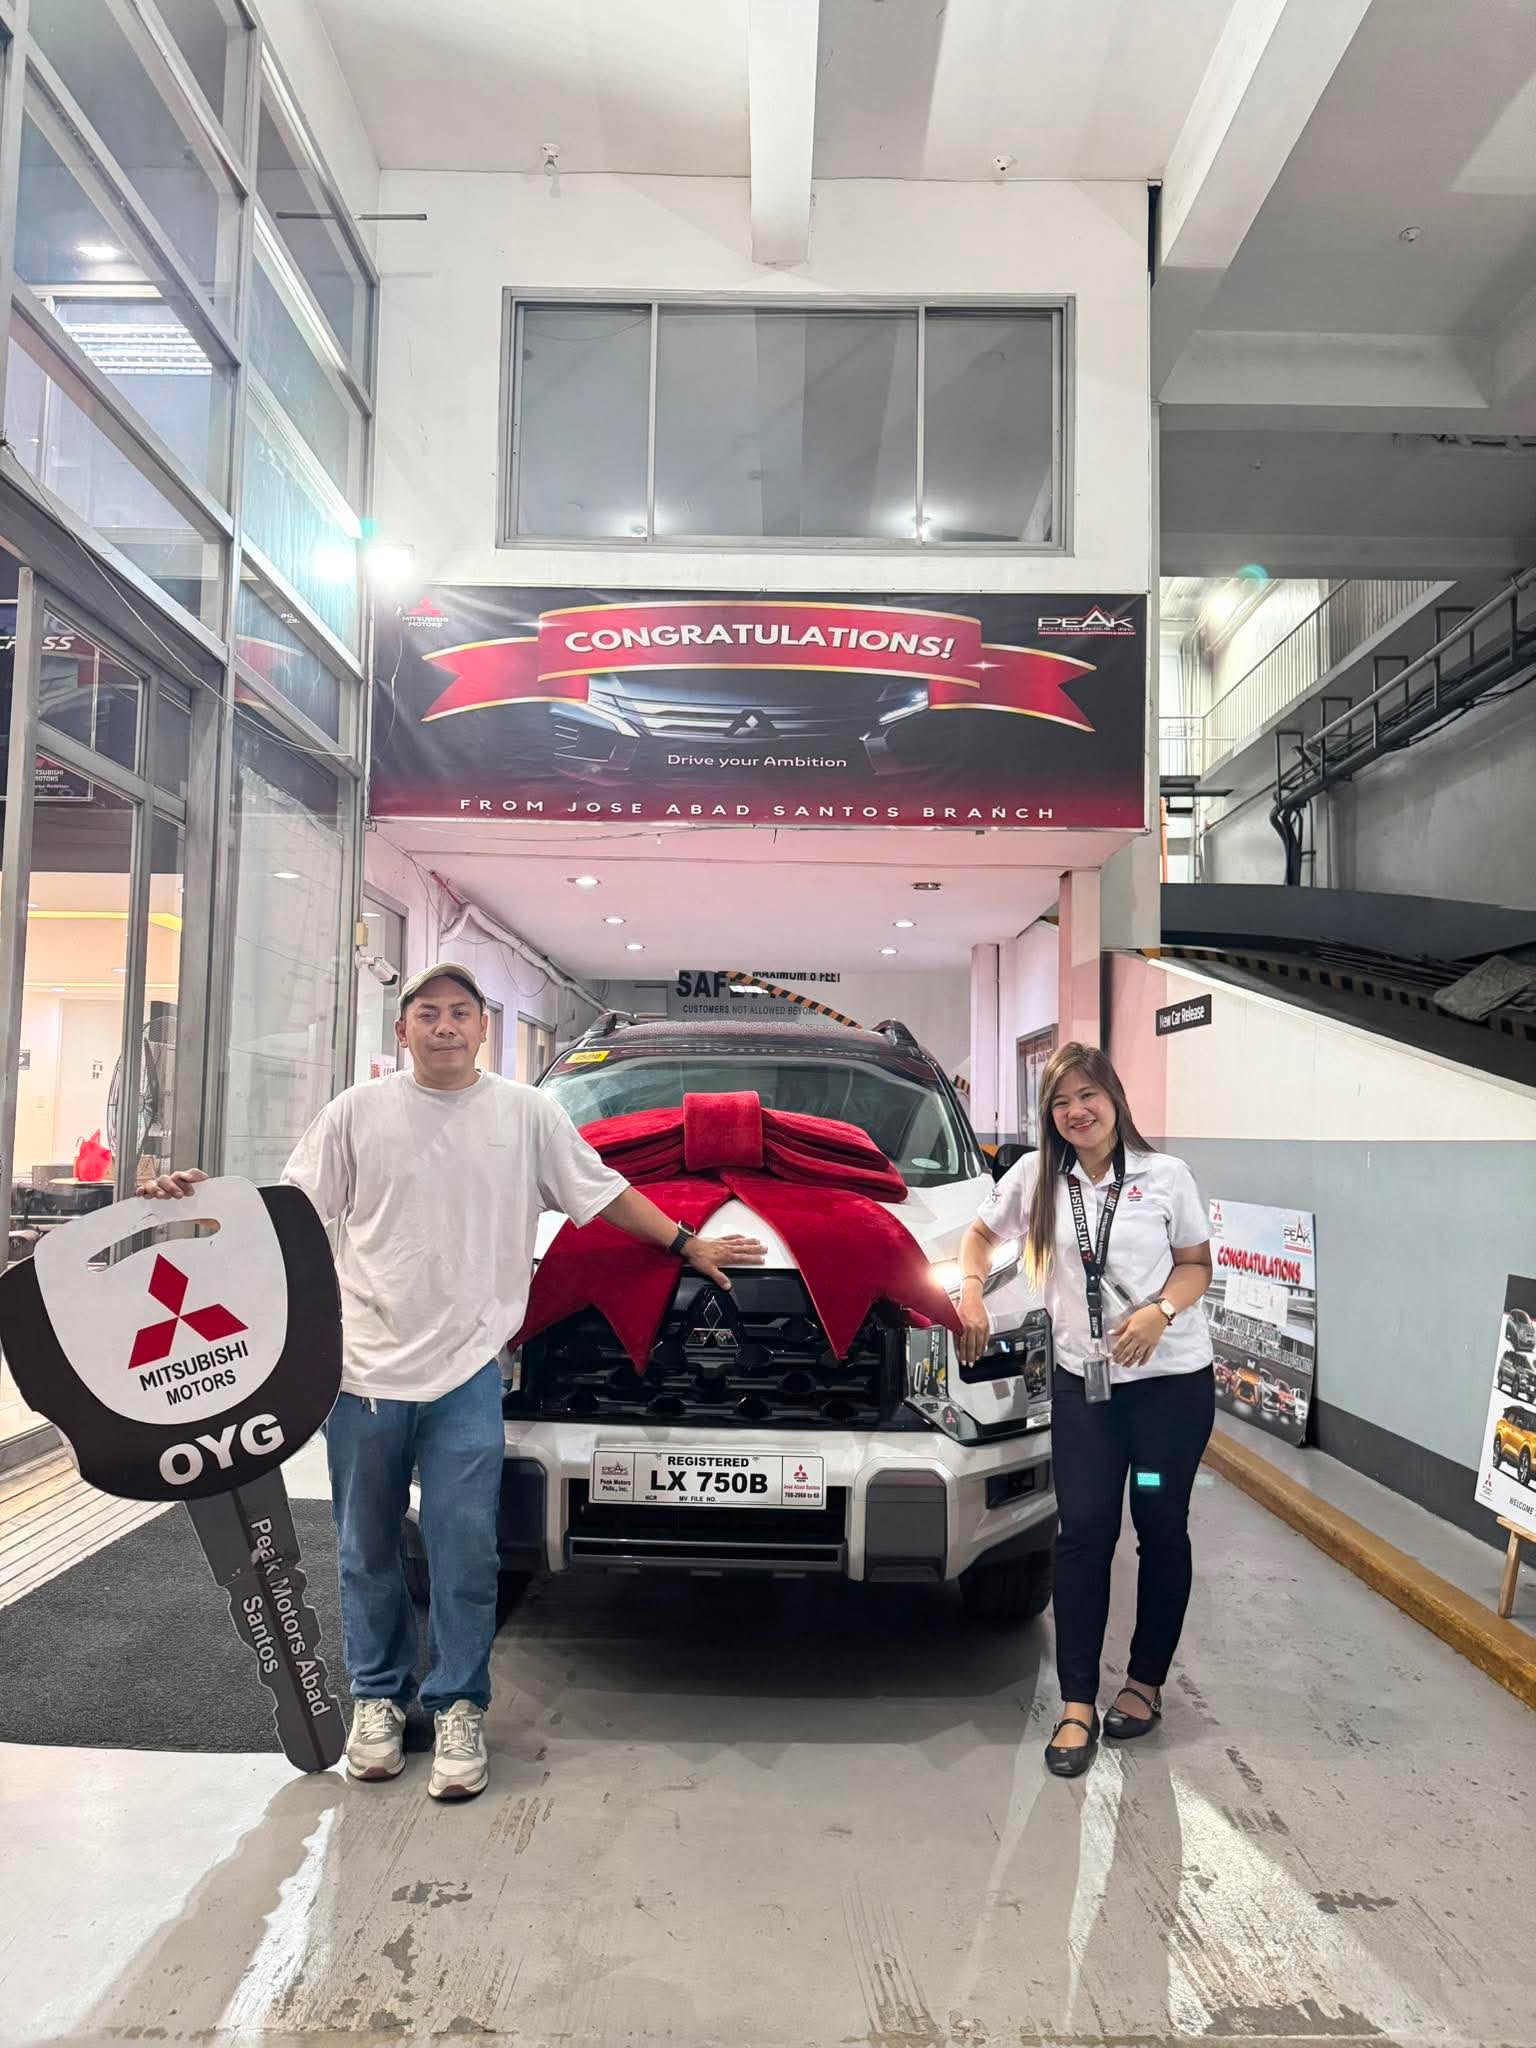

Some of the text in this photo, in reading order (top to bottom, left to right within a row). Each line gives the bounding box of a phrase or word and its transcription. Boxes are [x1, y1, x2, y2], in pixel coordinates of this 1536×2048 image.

[1038, 610, 1133, 627] PEAK
[564, 623, 956, 660] CONGRATULATIONS!
[667, 754, 847, 768] Drive your Ambition
[460, 799, 1053, 819] FROM JOSE ABAD SANTOS BRANCH
[682, 1004, 729, 1015] CUSTOMERS
[732, 1004, 748, 1015] NOT
[749, 1005, 786, 1016] ALLOWED
[1159, 1005, 1205, 1029] New Car Release
[1069, 1185, 1091, 1252] MITSUBISHI
[1217, 1245, 1302, 1286] CONGRATULATIONS
[139, 1340, 249, 1391] MITSUBISHI
[166, 1369, 236, 1405] MOTORS
[159, 1413, 285, 1485] OYG
[667, 1456, 750, 1468] REGISTERED
[650, 1470, 768, 1494] LX 750B
[1509, 1495, 1534, 1515] WELCOME
[251, 1518, 331, 1717] Peak Motors Abad
[243, 1595, 279, 1674] Santos
